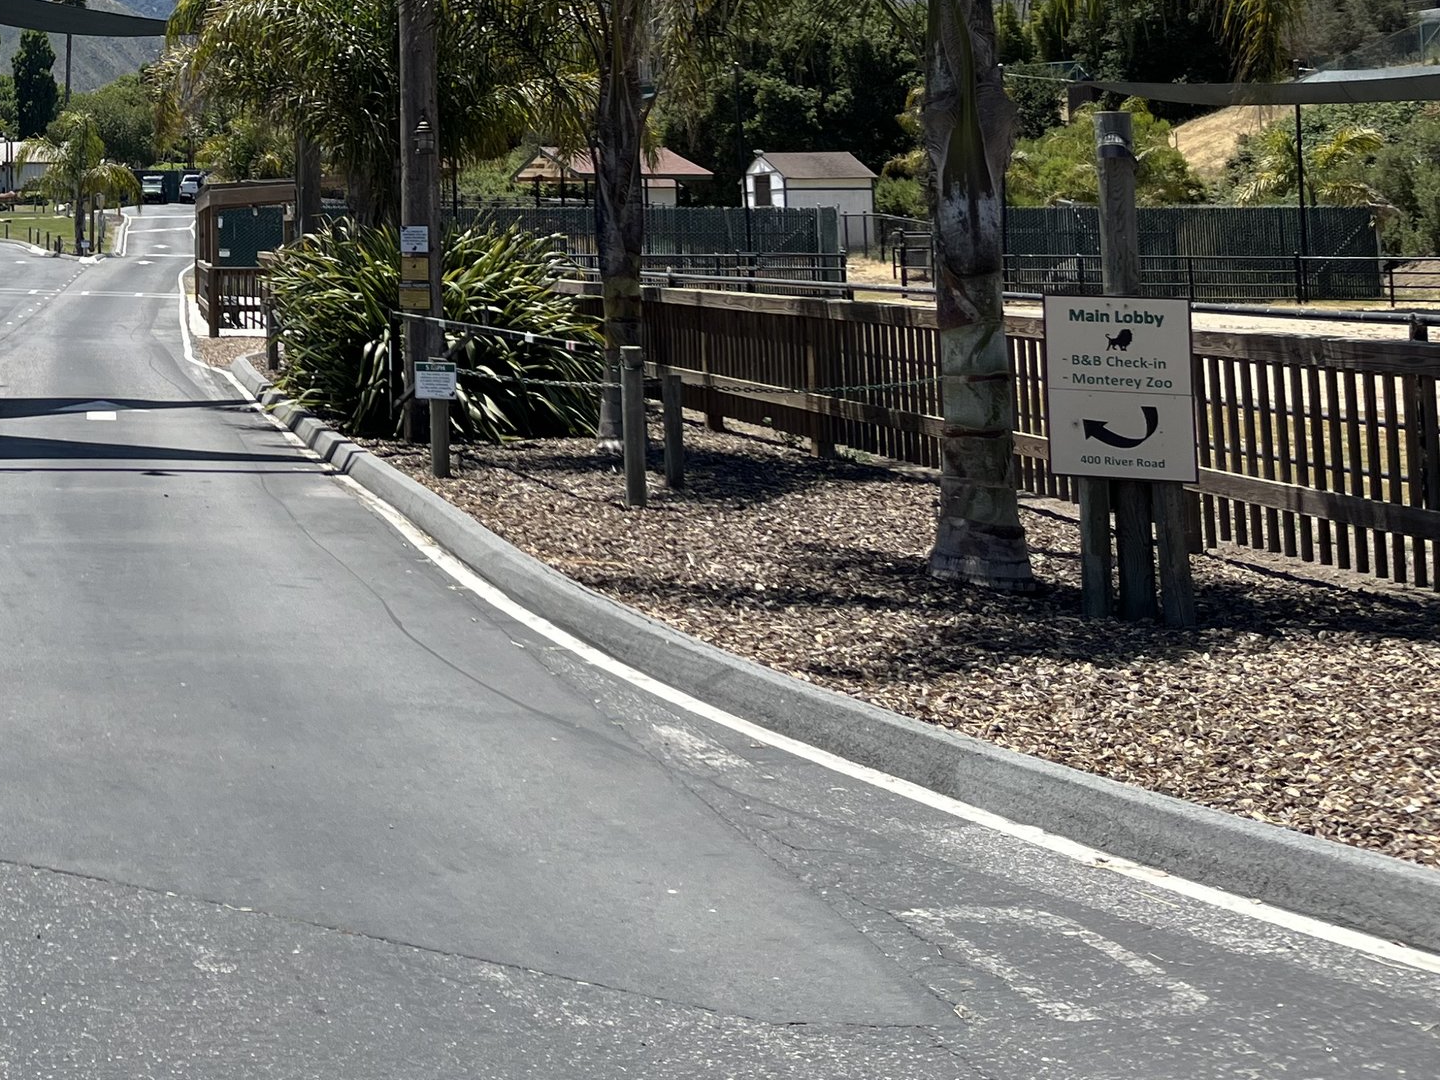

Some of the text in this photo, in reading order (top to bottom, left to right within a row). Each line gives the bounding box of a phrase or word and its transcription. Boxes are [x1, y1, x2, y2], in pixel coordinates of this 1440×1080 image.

[1068, 308, 1165, 328] Main Lobby
[1071, 354, 1167, 370] B&B Check-in
[1071, 372, 1173, 390] Monterey Zoo
[1080, 455, 1166, 469] 400 River Road
